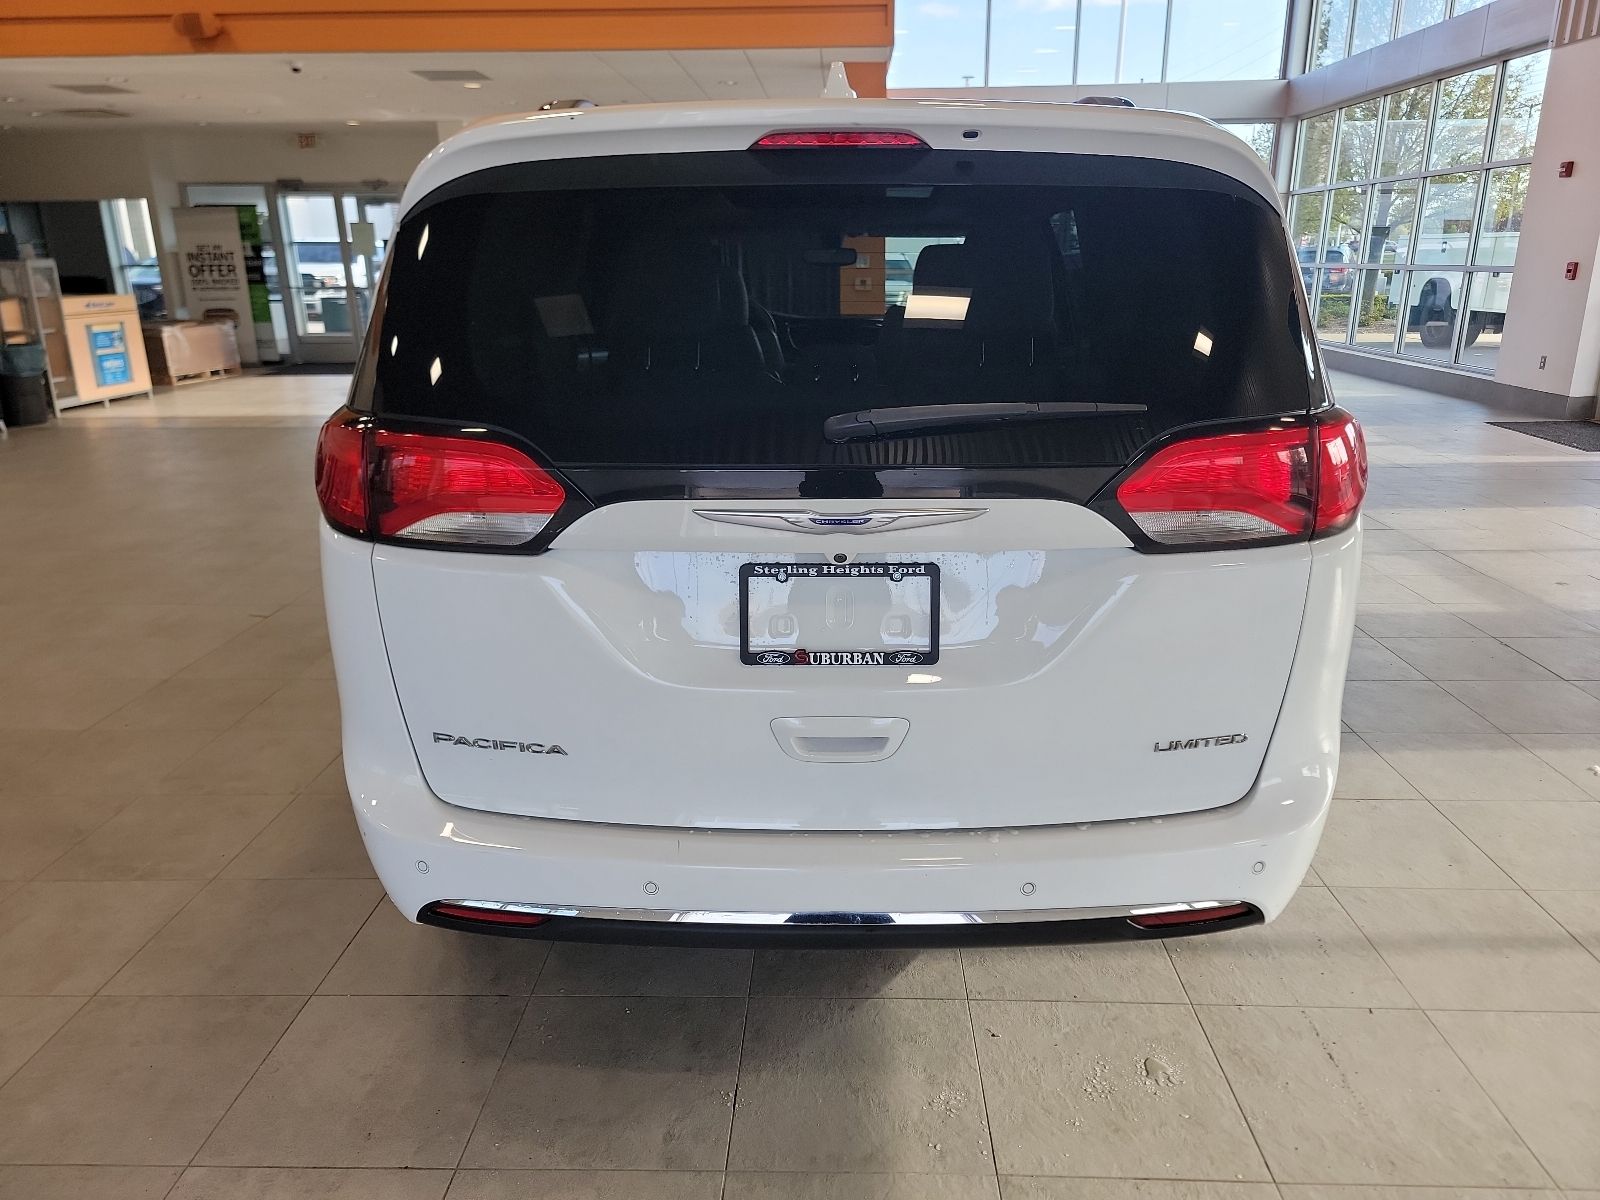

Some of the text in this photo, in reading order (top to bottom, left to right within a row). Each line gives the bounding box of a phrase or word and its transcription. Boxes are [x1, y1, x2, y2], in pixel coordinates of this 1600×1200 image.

[187, 252, 234, 262] INSTANT
[188, 264, 237, 277] OFFER
[753, 565, 926, 576] Sterling Heights Ford
[794, 651, 884, 665] SUBURBAN
[432, 732, 568, 756] PACIFICA
[1153, 733, 1249, 753] LIMITED
